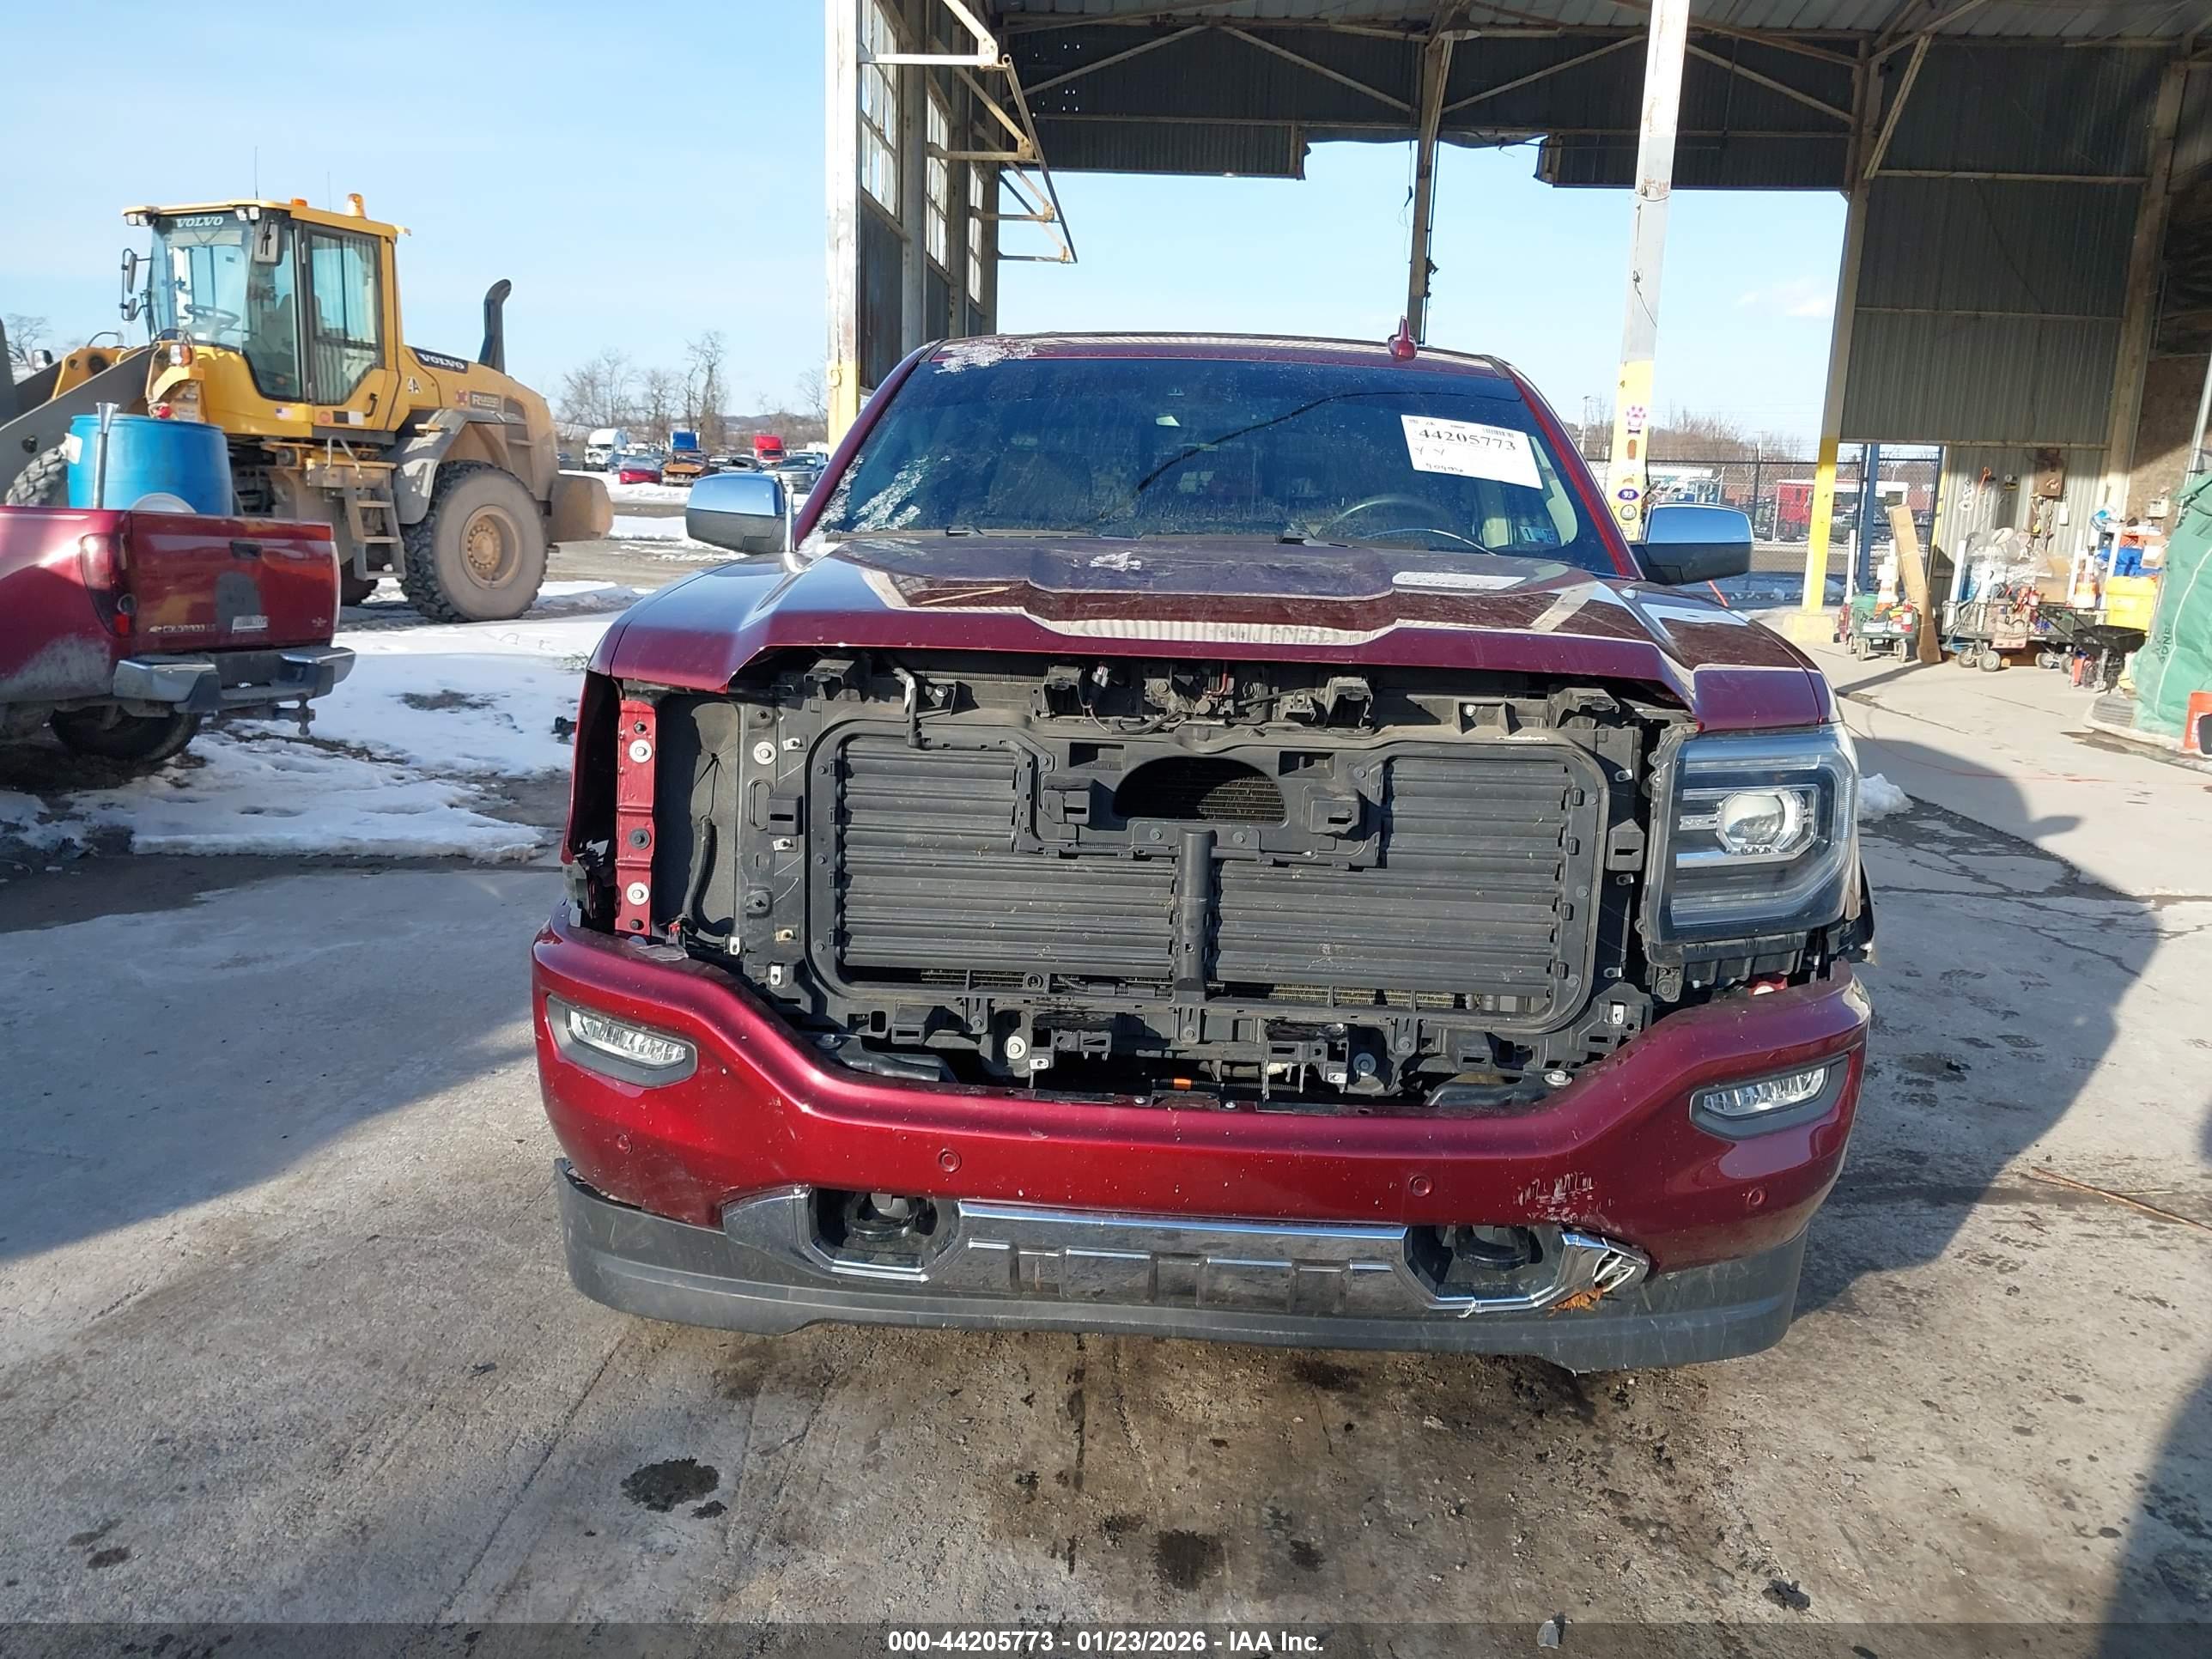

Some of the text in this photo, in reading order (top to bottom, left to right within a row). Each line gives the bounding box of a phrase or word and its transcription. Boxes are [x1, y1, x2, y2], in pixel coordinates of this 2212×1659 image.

[176, 216, 223, 228] VOLVO
[417, 352, 465, 370] VOLVO
[1418, 428, 1516, 452] 44205773
